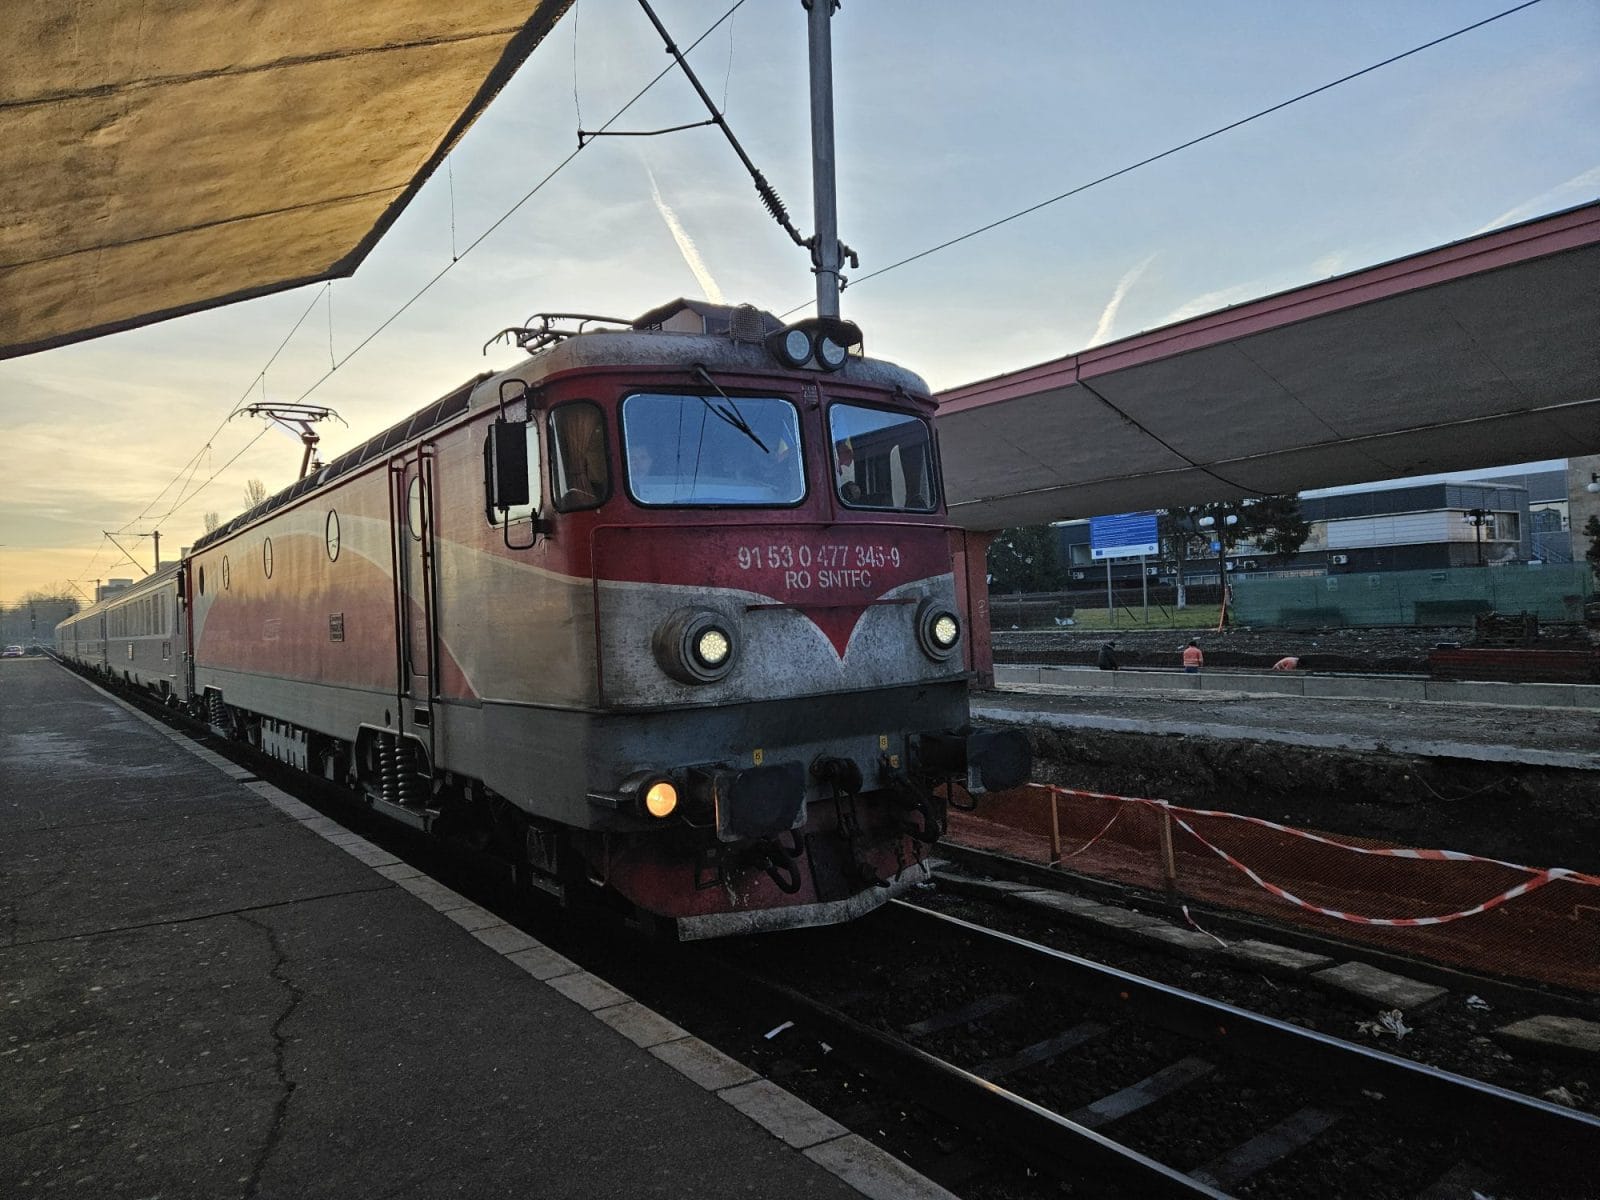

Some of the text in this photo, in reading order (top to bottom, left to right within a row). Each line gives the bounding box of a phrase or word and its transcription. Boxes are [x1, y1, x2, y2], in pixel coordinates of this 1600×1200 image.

[738, 544, 900, 569] 91 53 0 477 345-9
[785, 569, 872, 590] RO SNTFC
